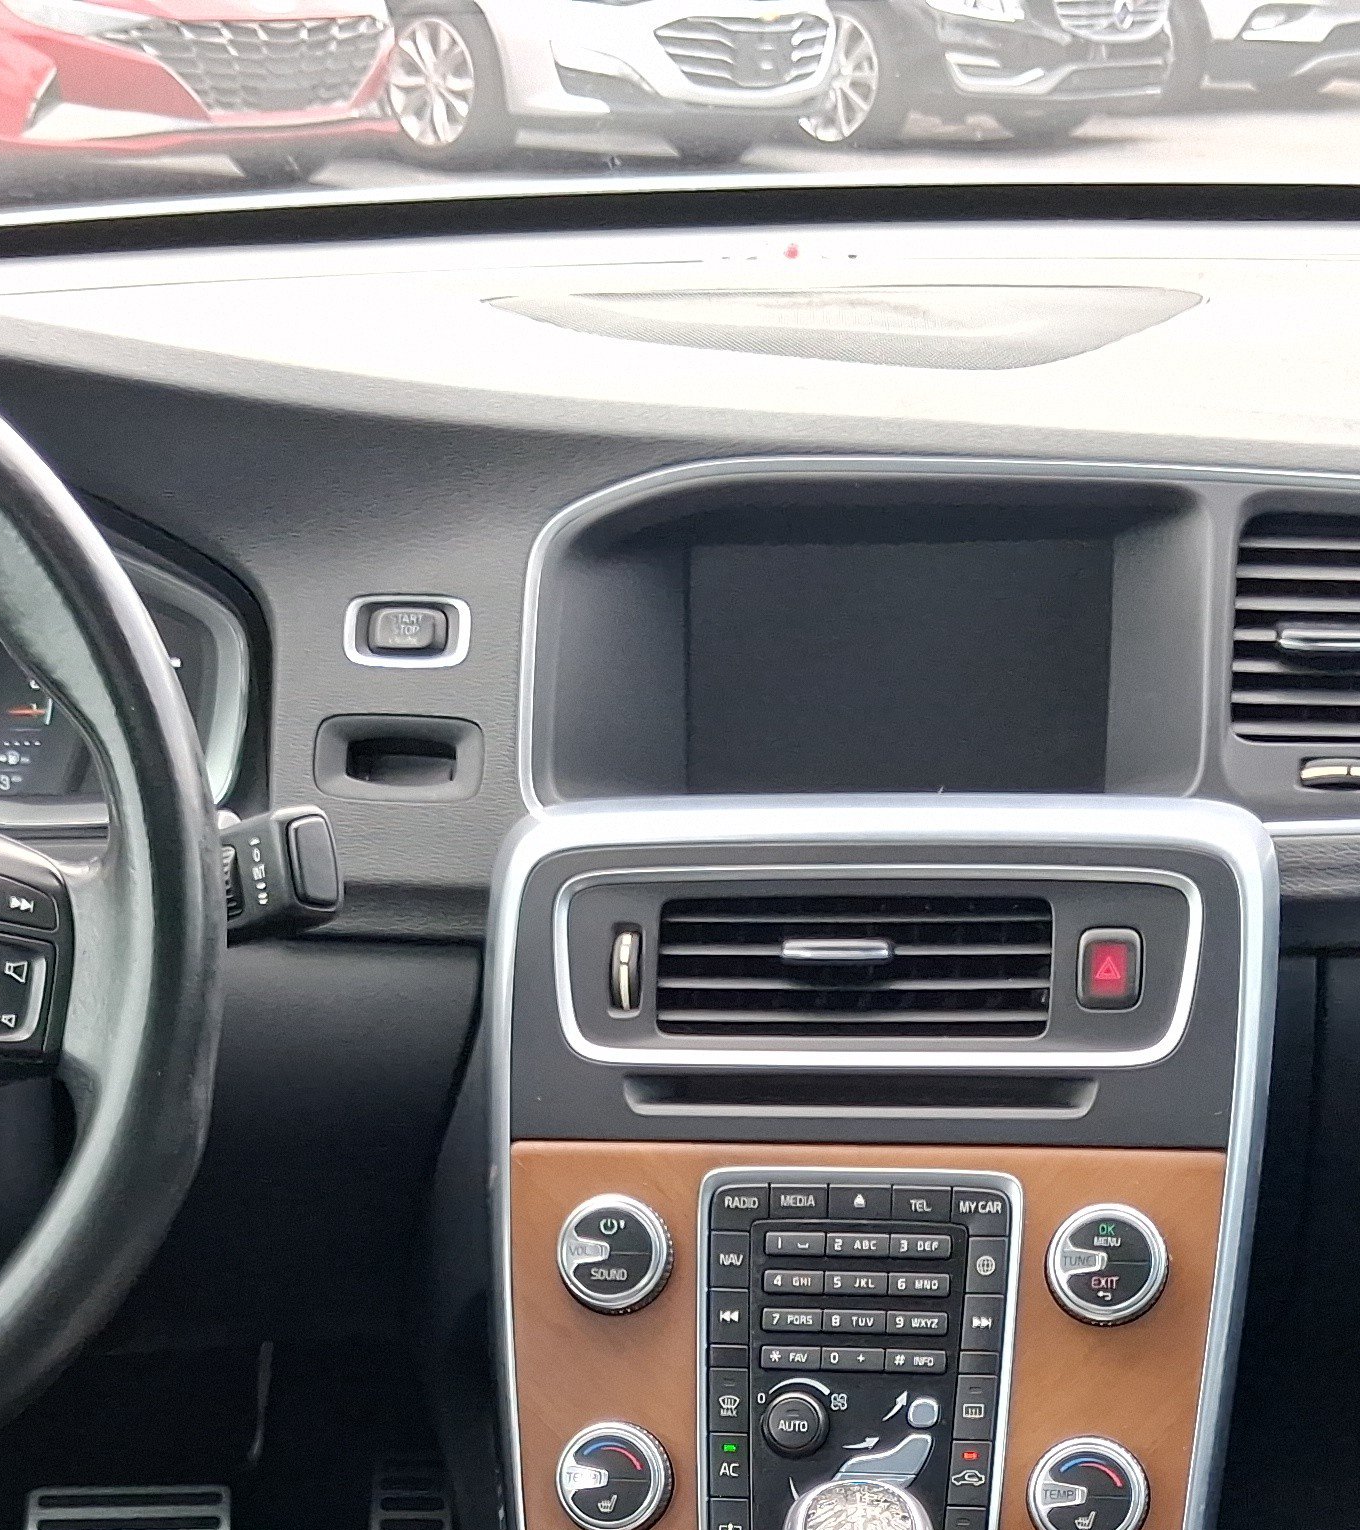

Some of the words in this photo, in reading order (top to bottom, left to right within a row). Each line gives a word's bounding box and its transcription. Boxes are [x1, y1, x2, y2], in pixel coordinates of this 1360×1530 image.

[724, 1195, 759, 1210] RADIO
[779, 1194, 816, 1208] MEDIA
[909, 1199, 932, 1213] TEL
[958, 1201, 978, 1213] MY
[978, 1201, 1003, 1214] CAR
[1098, 1223, 1117, 1236] OK
[776, 1238, 783, 1249] 1
[834, 1239, 843, 1251] 2
[852, 1239, 878, 1250] ABC
[899, 1239, 909, 1252] 3
[916, 1240, 940, 1251] DEF
[1093, 1236, 1122, 1247] MENU
[719, 1252, 744, 1267] NAV
[590, 1266, 628, 1281] SOUND
[773, 1274, 782, 1287] 4
[792, 1276, 812, 1287] GHI
[833, 1276, 842, 1288] 5
[852, 1277, 876, 1288] JKL
[897, 1278, 906, 1290] 6
[914, 1279, 939, 1290] MNO
[1091, 1276, 1120, 1290] EXIT
[772, 1313, 781, 1325] 7
[787, 1313, 814, 1325] PQRS
[831, 1315, 841, 1327] 8
[851, 1316, 875, 1328] TUV
[895, 1316, 904, 1328] 9
[911, 1317, 939, 1329] WXYZ
[789, 1351, 808, 1363] FAV
[829, 1351, 839, 1364] 0
[913, 1356, 935, 1367] INFO
[757, 1392, 766, 1405] 0
[720, 1407, 739, 1418] MAX
[777, 1419, 808, 1432] AUTO
[718, 1462, 740, 1478] AC
[1042, 1488, 1075, 1500] TEMP
